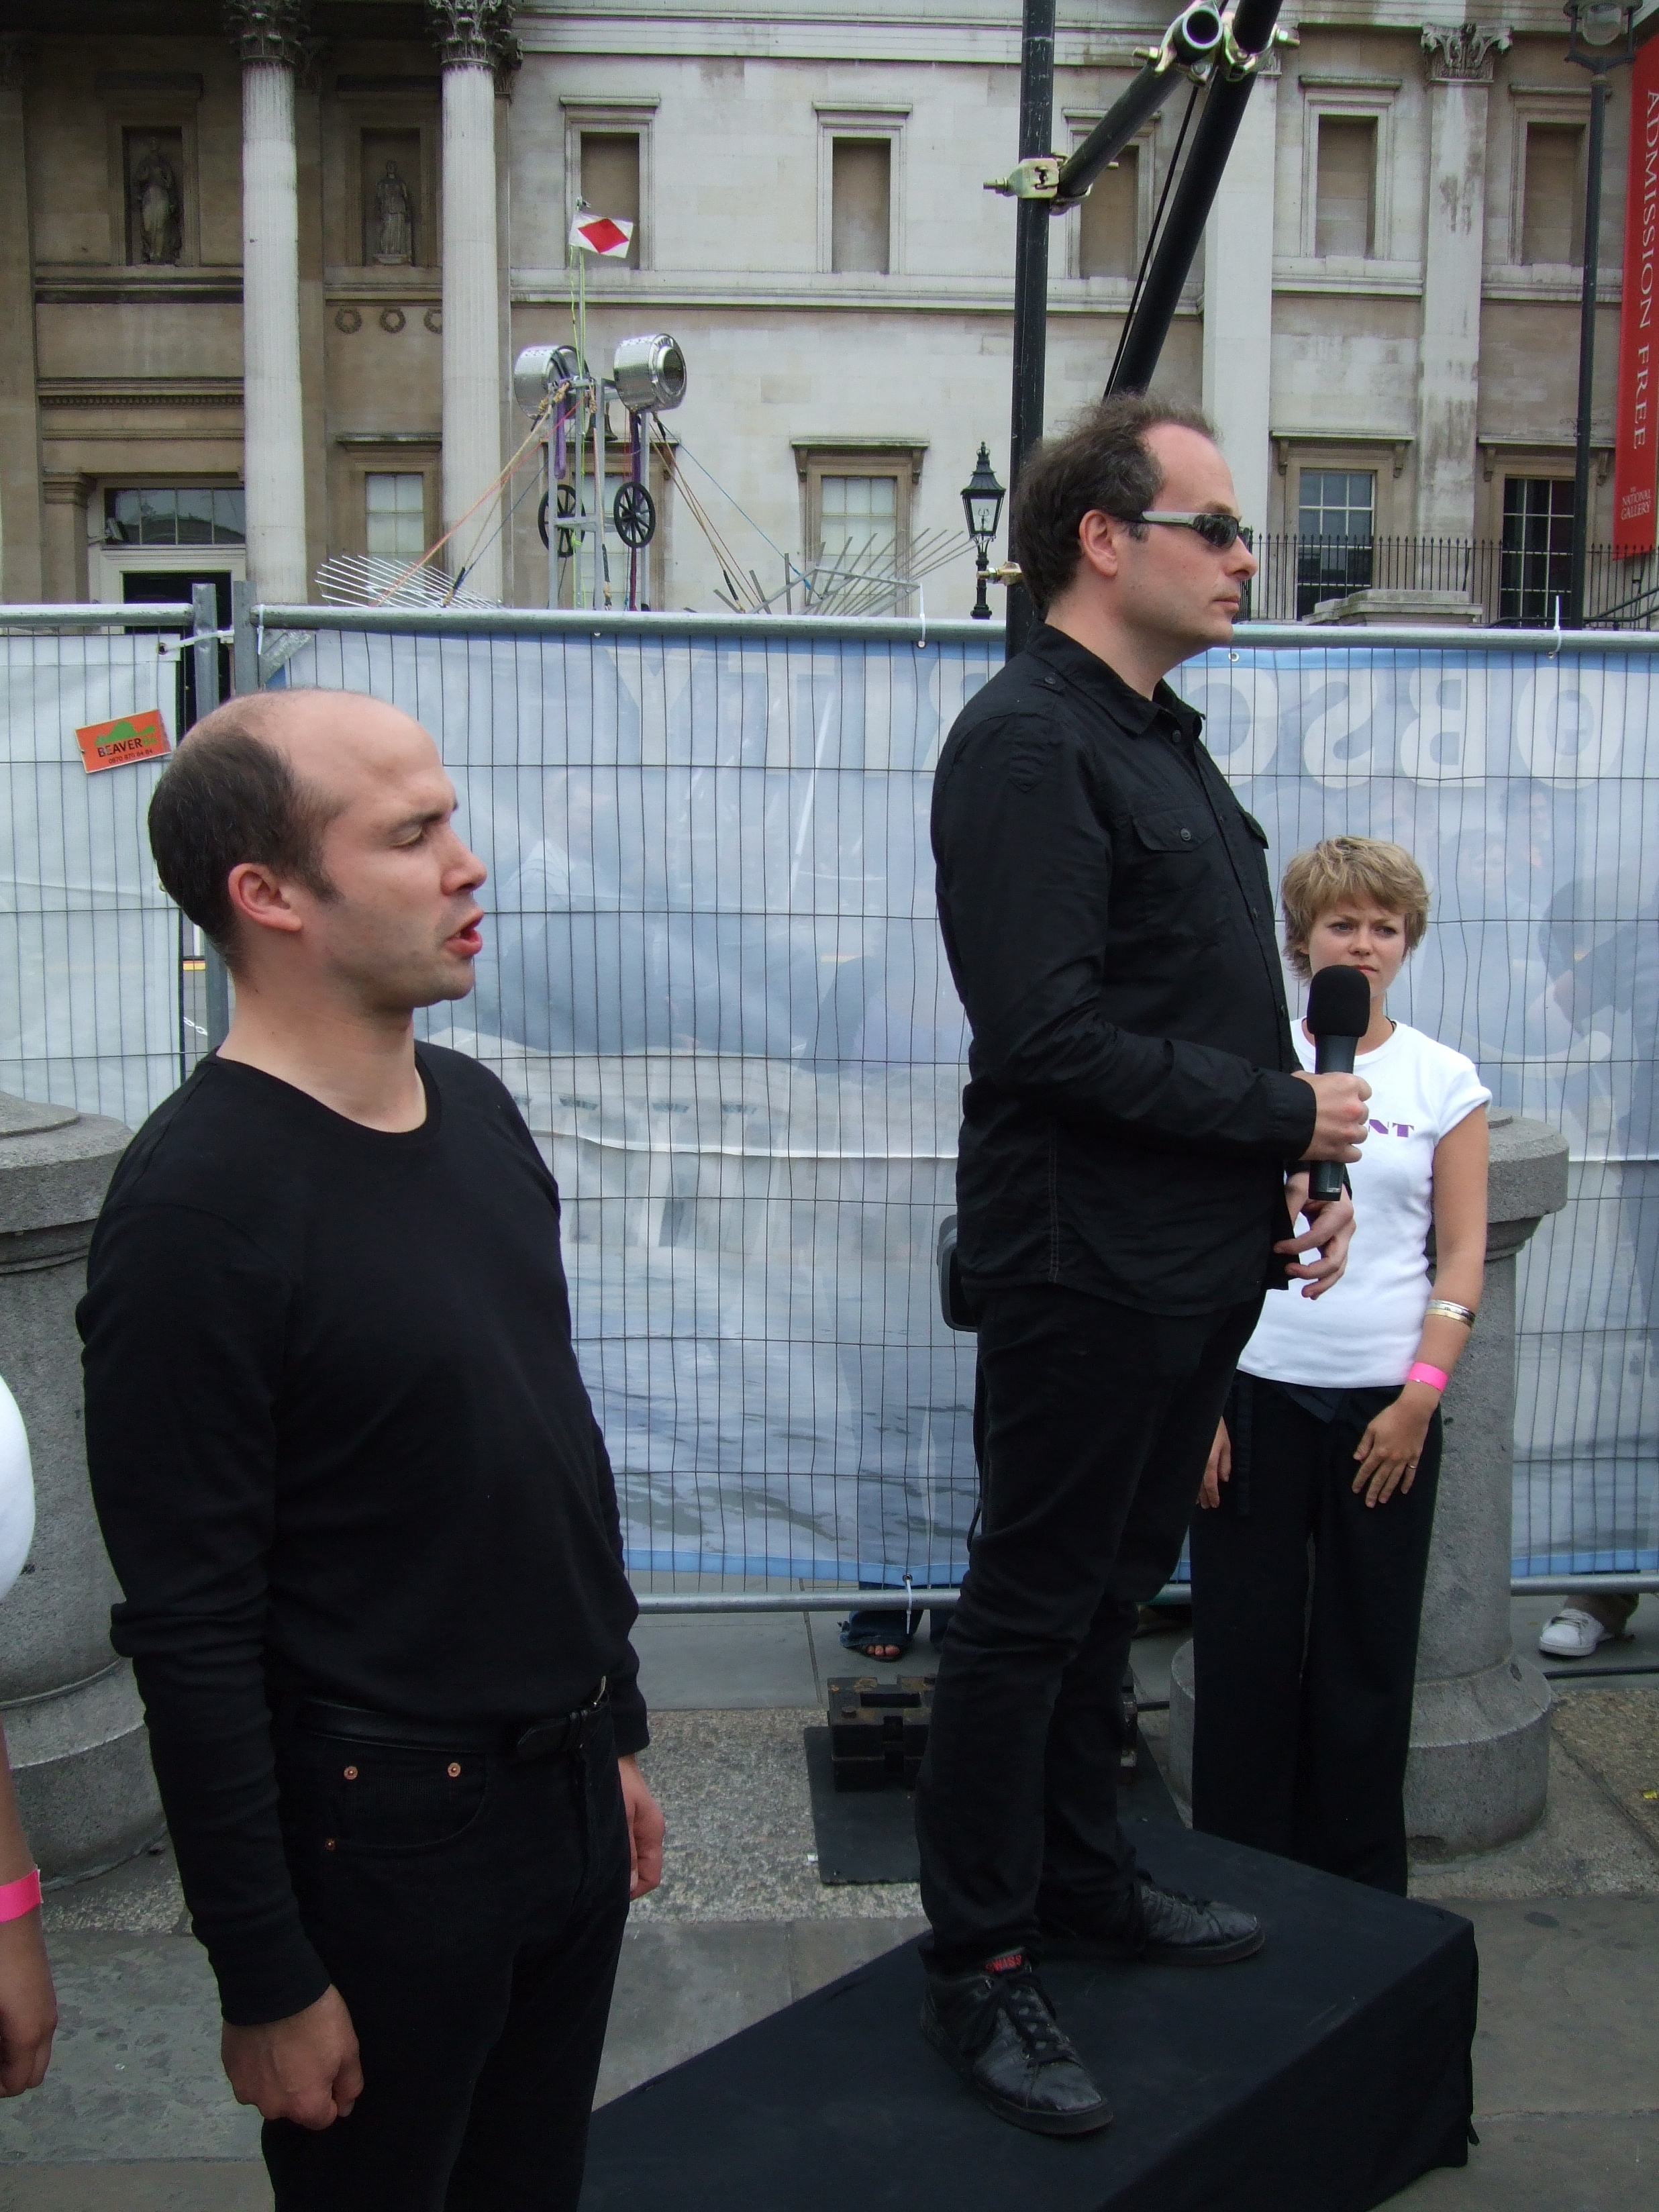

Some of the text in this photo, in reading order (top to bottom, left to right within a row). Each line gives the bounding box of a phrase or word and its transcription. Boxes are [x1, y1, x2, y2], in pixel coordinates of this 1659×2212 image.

[1633, 90, 1659, 449] ADMISSION FREE
[1621, 501, 1650, 521] GALLERY
